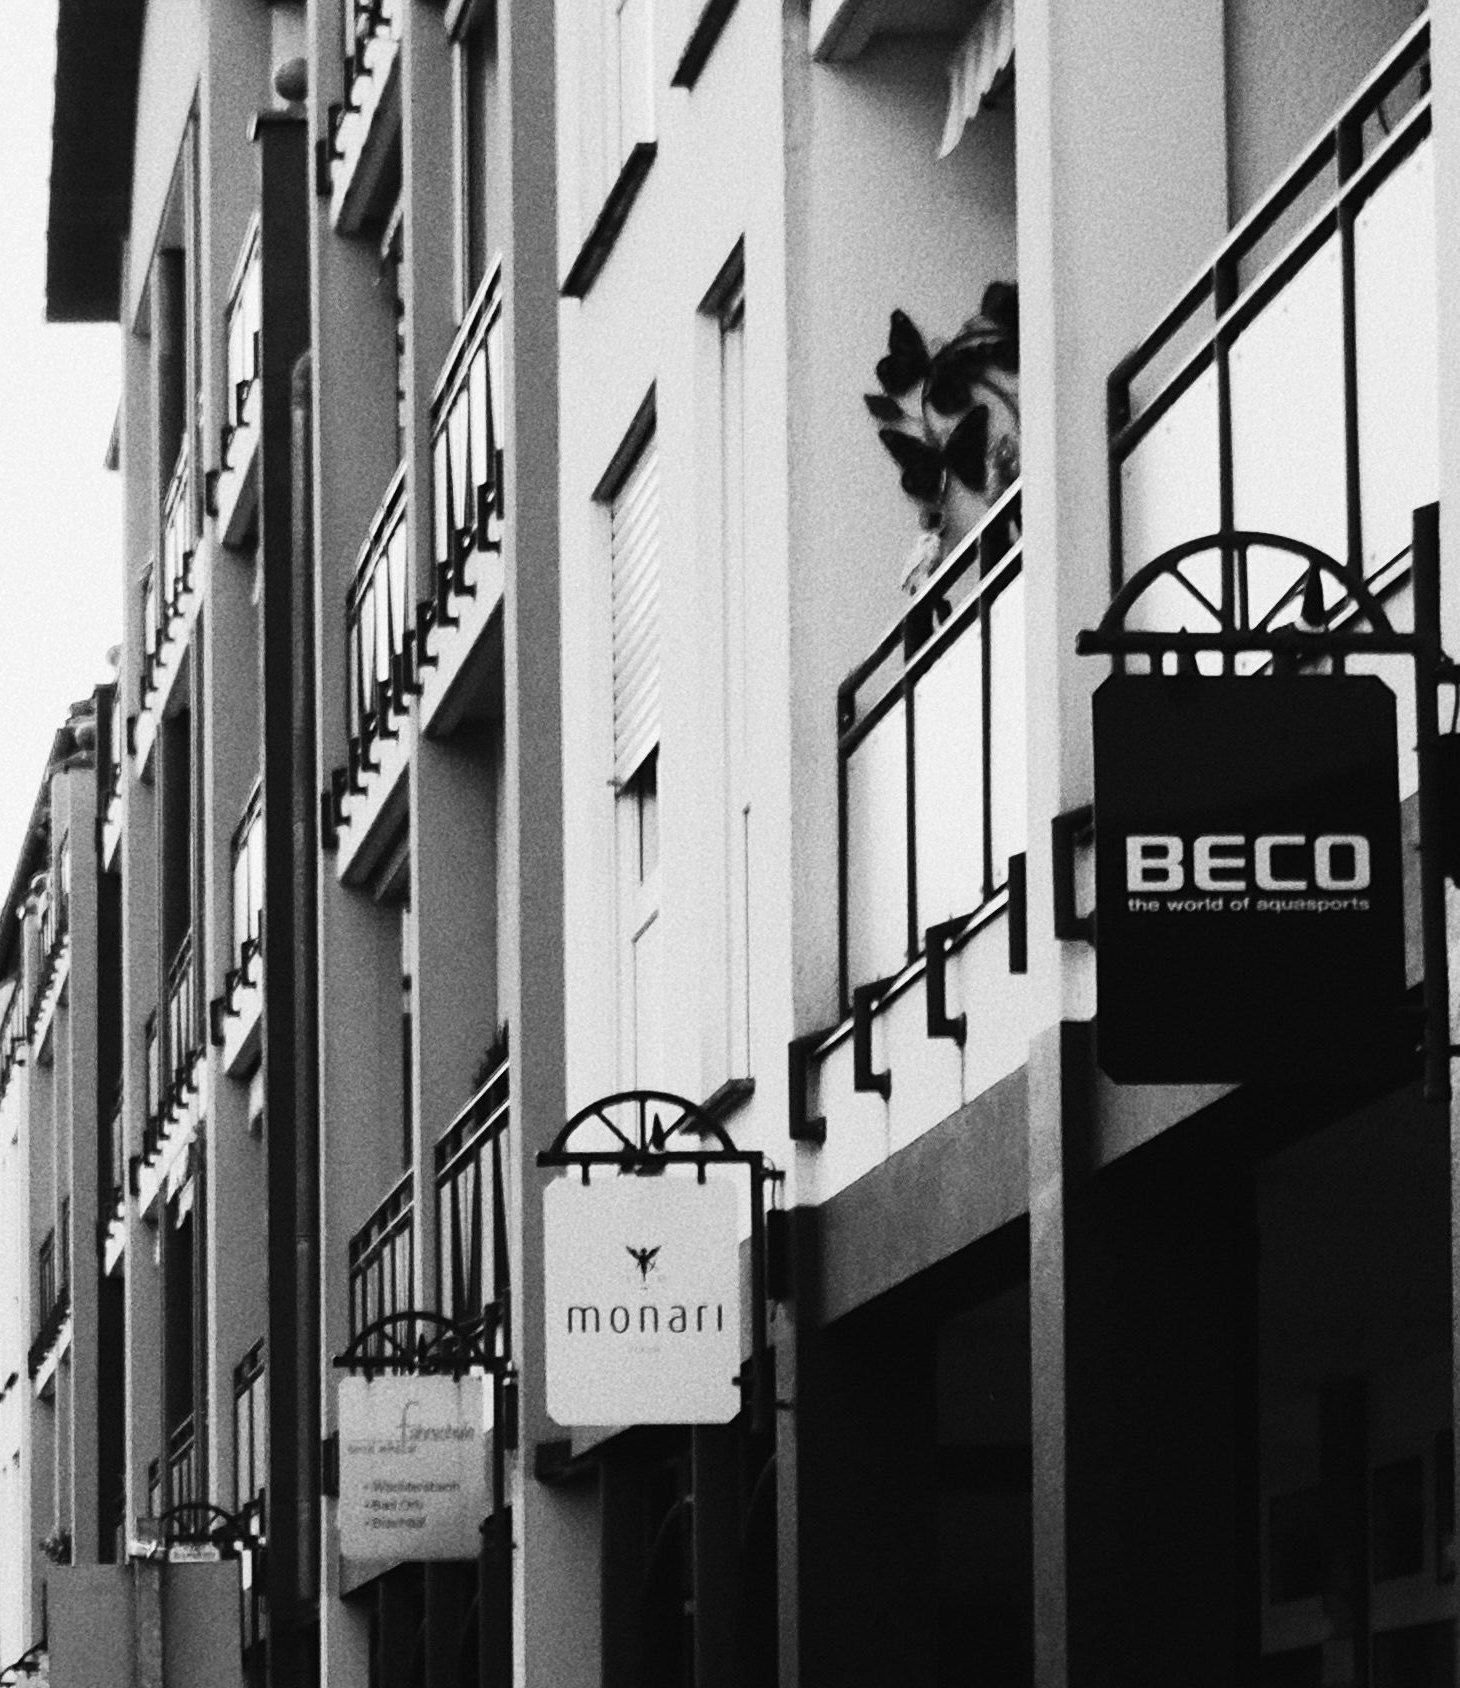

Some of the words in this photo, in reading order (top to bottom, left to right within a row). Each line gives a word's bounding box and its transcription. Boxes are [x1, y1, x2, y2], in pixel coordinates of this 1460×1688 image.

[1126, 835, 1371, 892] BECO
[1128, 898, 1160, 912] the
[1167, 898, 1224, 912] world
[1230, 897, 1250, 912] of
[1256, 897, 1371, 914] aquasports
[567, 1304, 723, 1334] monari
